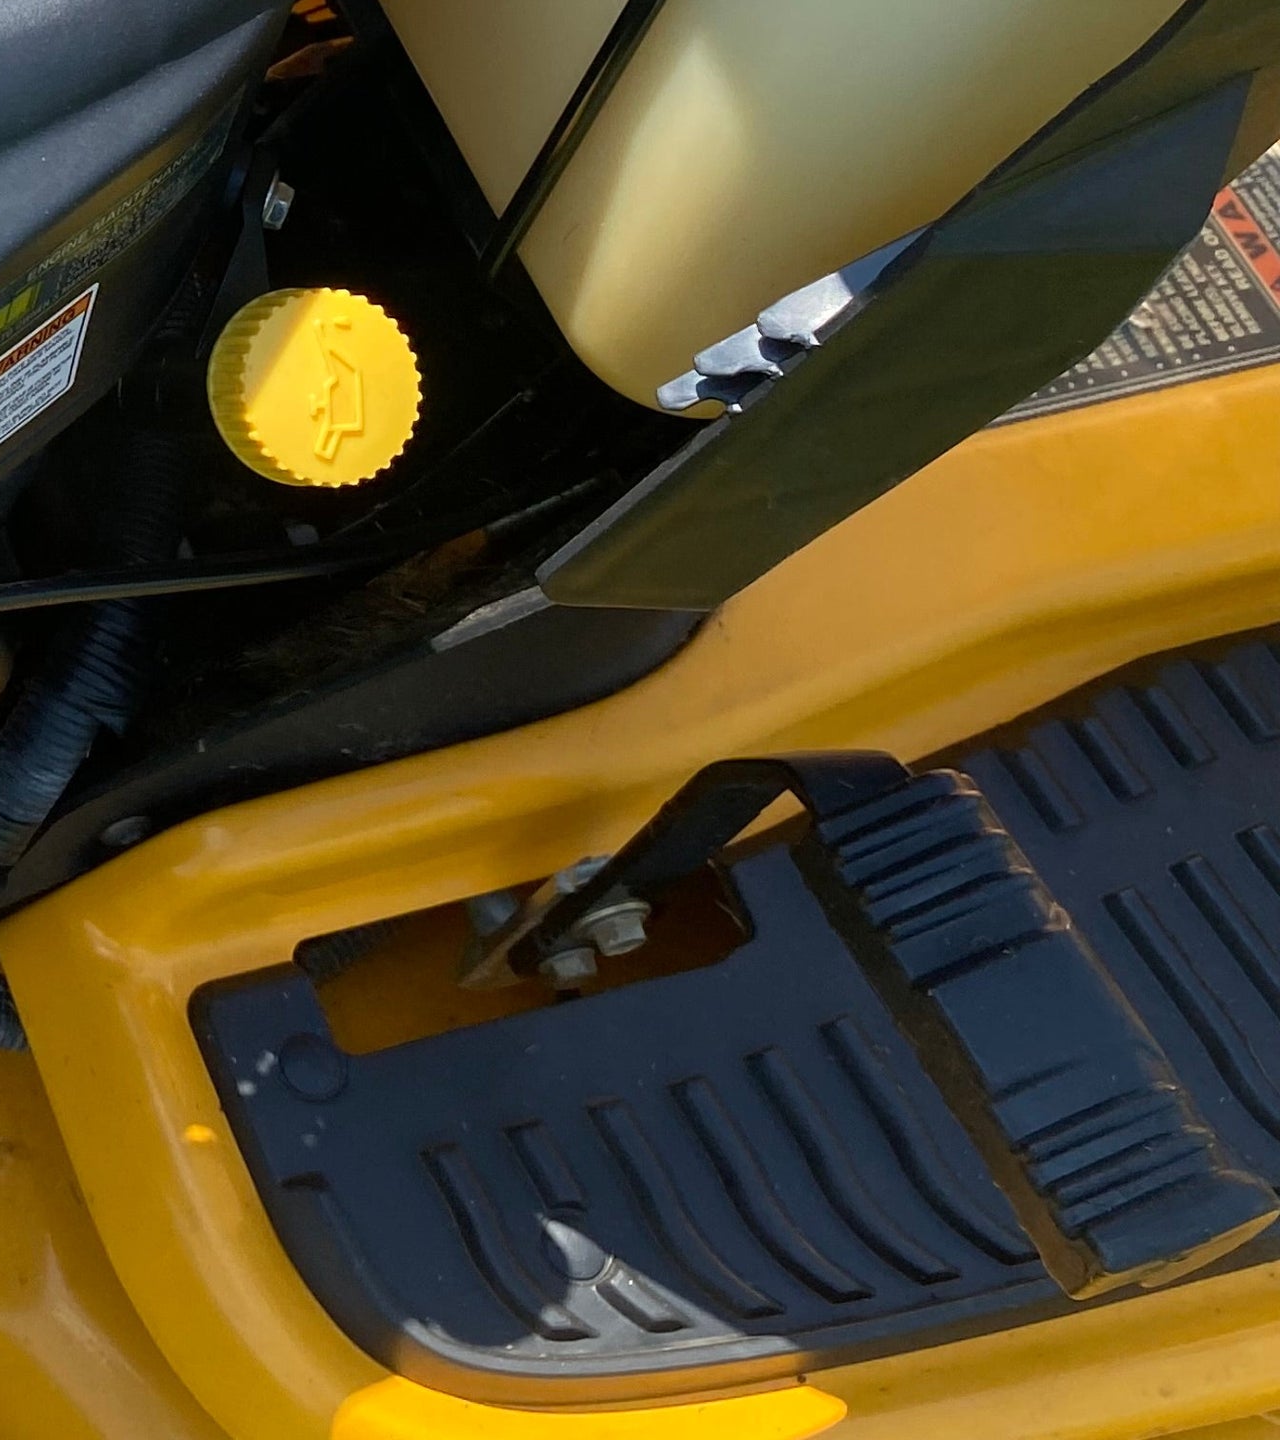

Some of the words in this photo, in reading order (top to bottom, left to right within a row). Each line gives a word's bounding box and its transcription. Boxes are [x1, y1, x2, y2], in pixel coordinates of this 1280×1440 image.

[27, 229, 90, 282] ENGINE
[1213, 248, 1250, 289] READ
[1221, 287, 1261, 333] REMOVE
